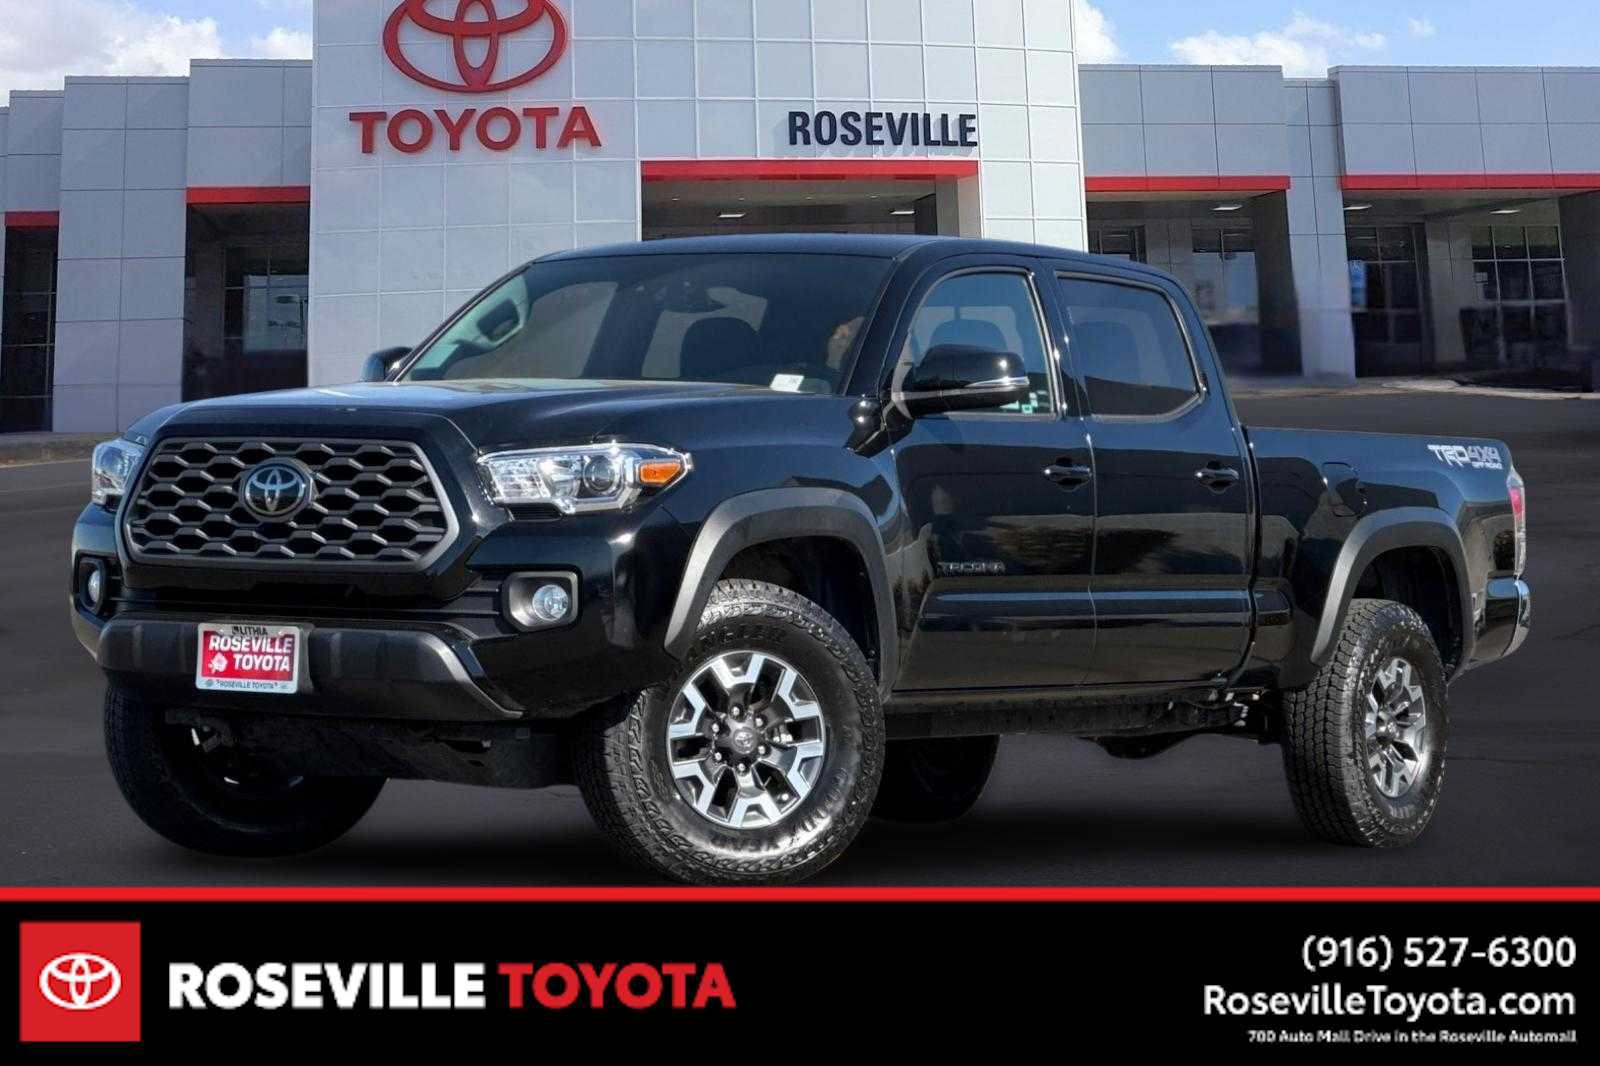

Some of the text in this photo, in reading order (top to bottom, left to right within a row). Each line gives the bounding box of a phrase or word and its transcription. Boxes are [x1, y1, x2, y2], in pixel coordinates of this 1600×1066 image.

[349, 106, 602, 154] TOYOTA
[788, 110, 978, 148] ROSEVILLE
[1427, 444, 1470, 468] TRD
[208, 635, 293, 654] ROSEVILLE
[233, 653, 290, 672] TOYOTA
